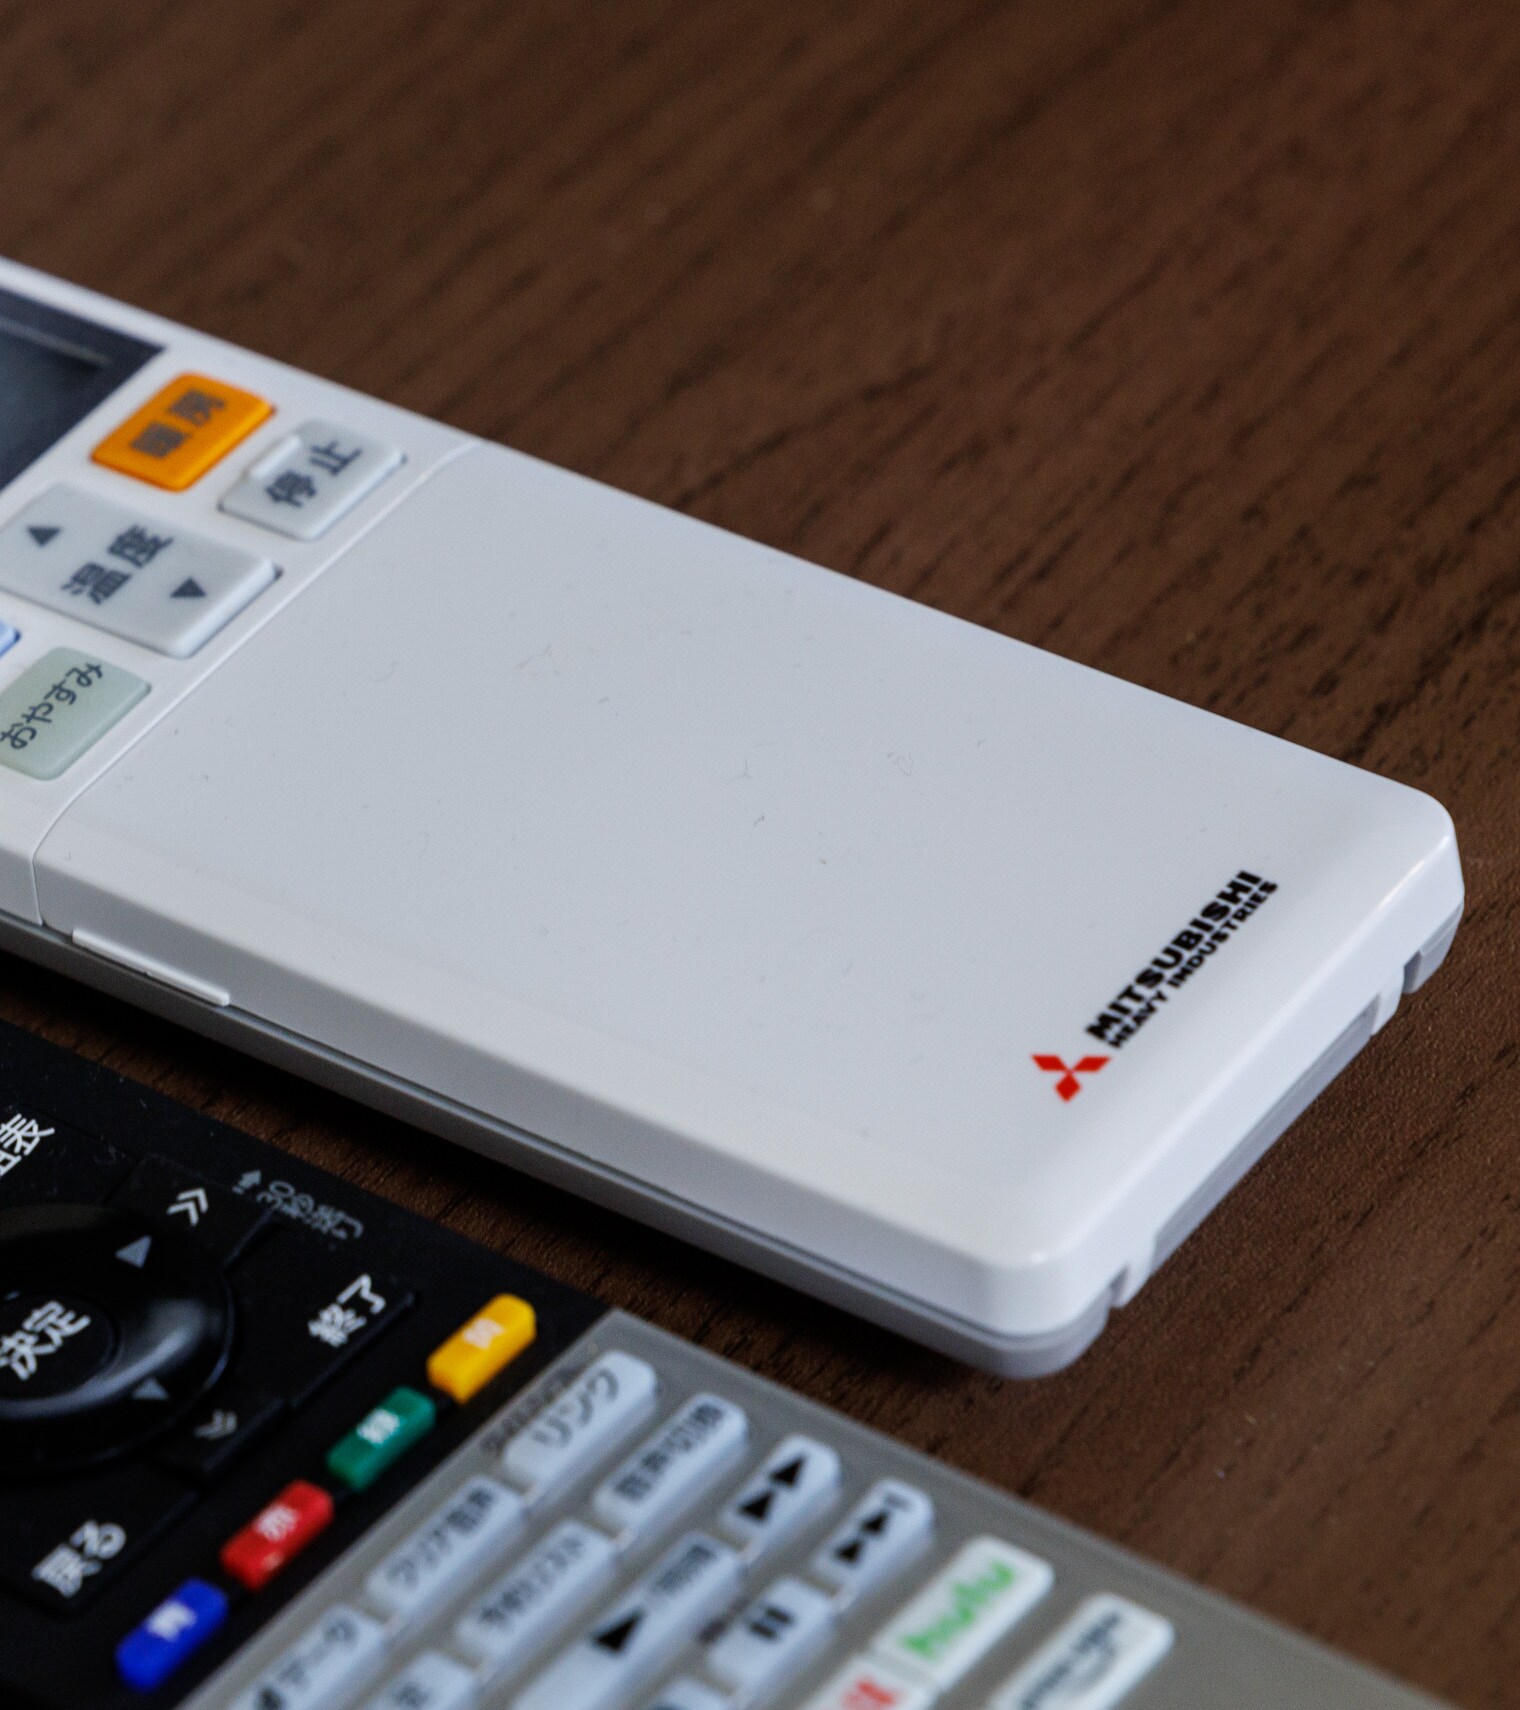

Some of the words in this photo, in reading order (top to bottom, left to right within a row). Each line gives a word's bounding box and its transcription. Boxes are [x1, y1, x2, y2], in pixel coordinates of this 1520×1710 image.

[264, 440, 364, 510] 停止
[60, 523, 174, 606] 温度
[0, 660, 107, 750] おやすみ
[1084, 869, 1263, 1042] MITSUBISHI
[1107, 989, 1169, 1050] HEAVY
[1165, 880, 1279, 989] INDUSTRIES
[308, 1274, 386, 1348] 終了
[31, 1521, 128, 1598] 戻る
